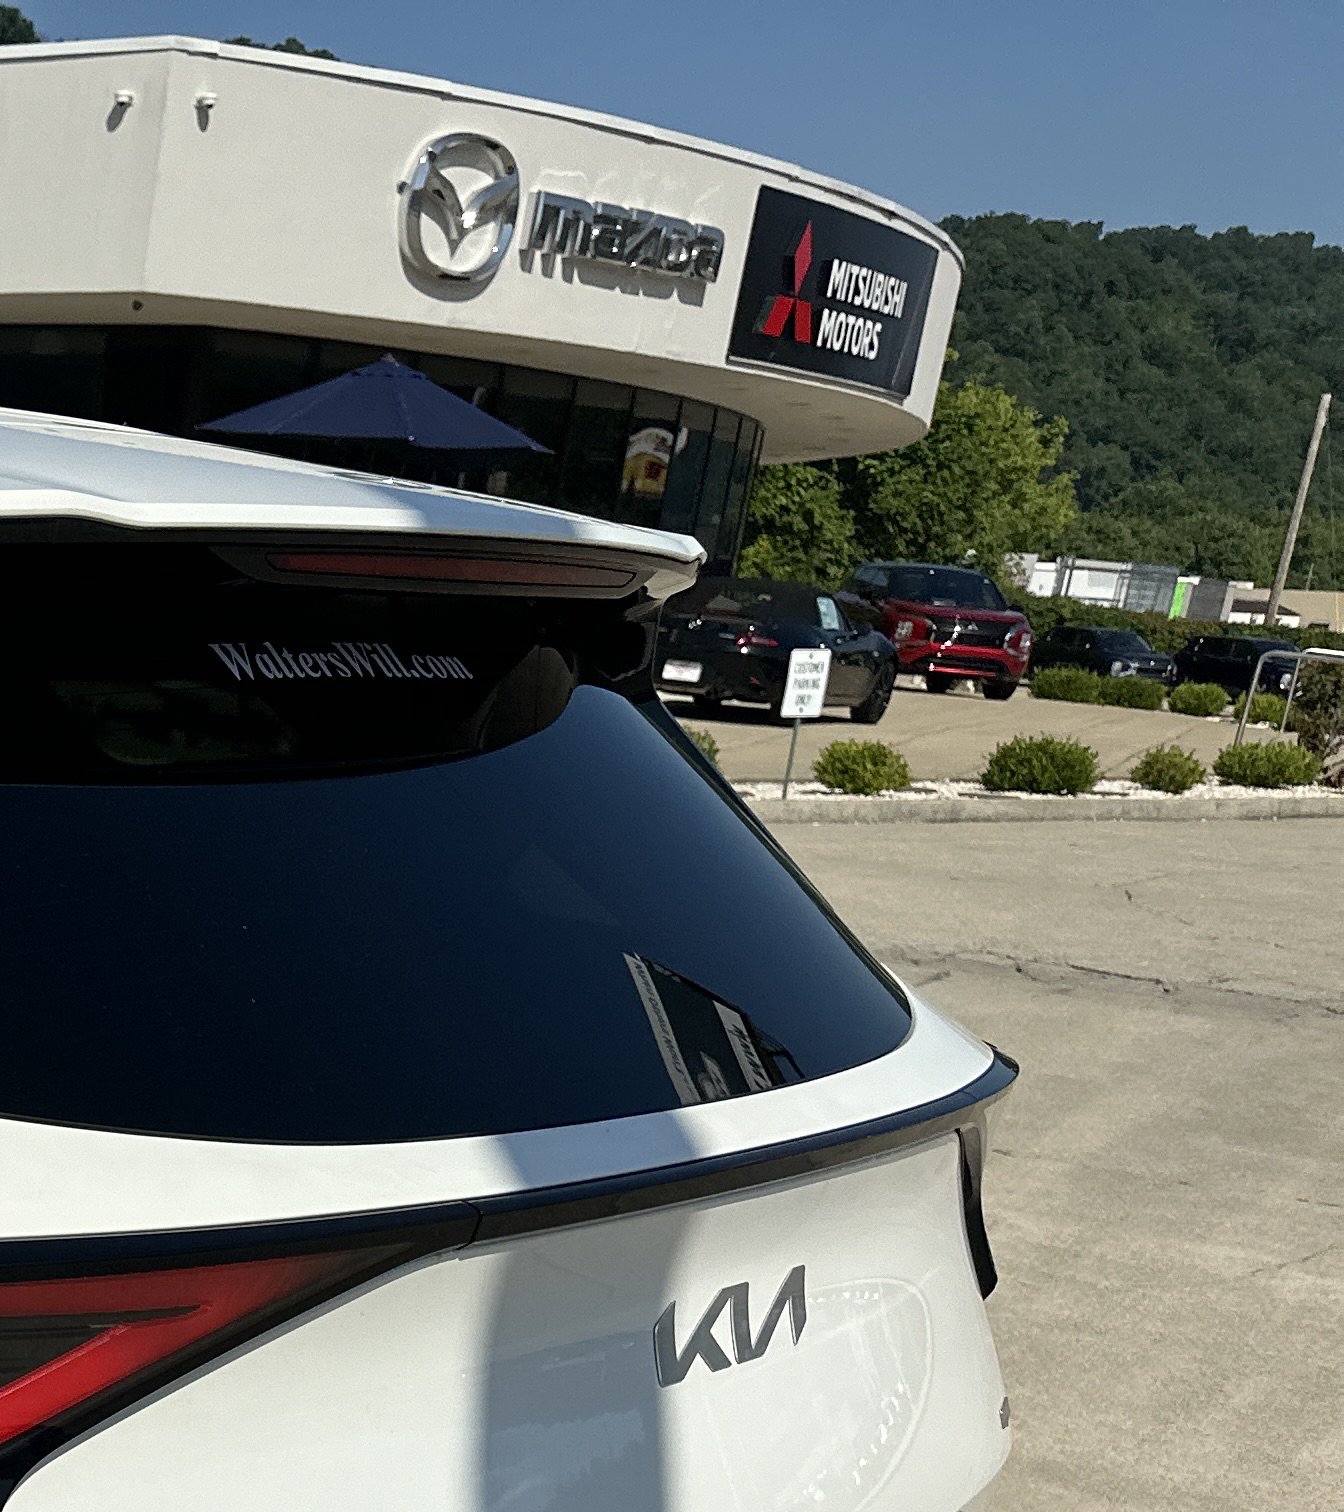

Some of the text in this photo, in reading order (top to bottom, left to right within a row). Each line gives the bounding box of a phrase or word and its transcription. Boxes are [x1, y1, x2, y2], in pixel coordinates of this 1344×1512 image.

[528, 190, 725, 284] mazda
[826, 257, 909, 320] MITSUBISHI
[816, 308, 883, 361] MOTORS
[208, 641, 474, 682] WaltersWill.com
[792, 677, 821, 690] PARKING
[793, 661, 825, 674] CUSTOMER
